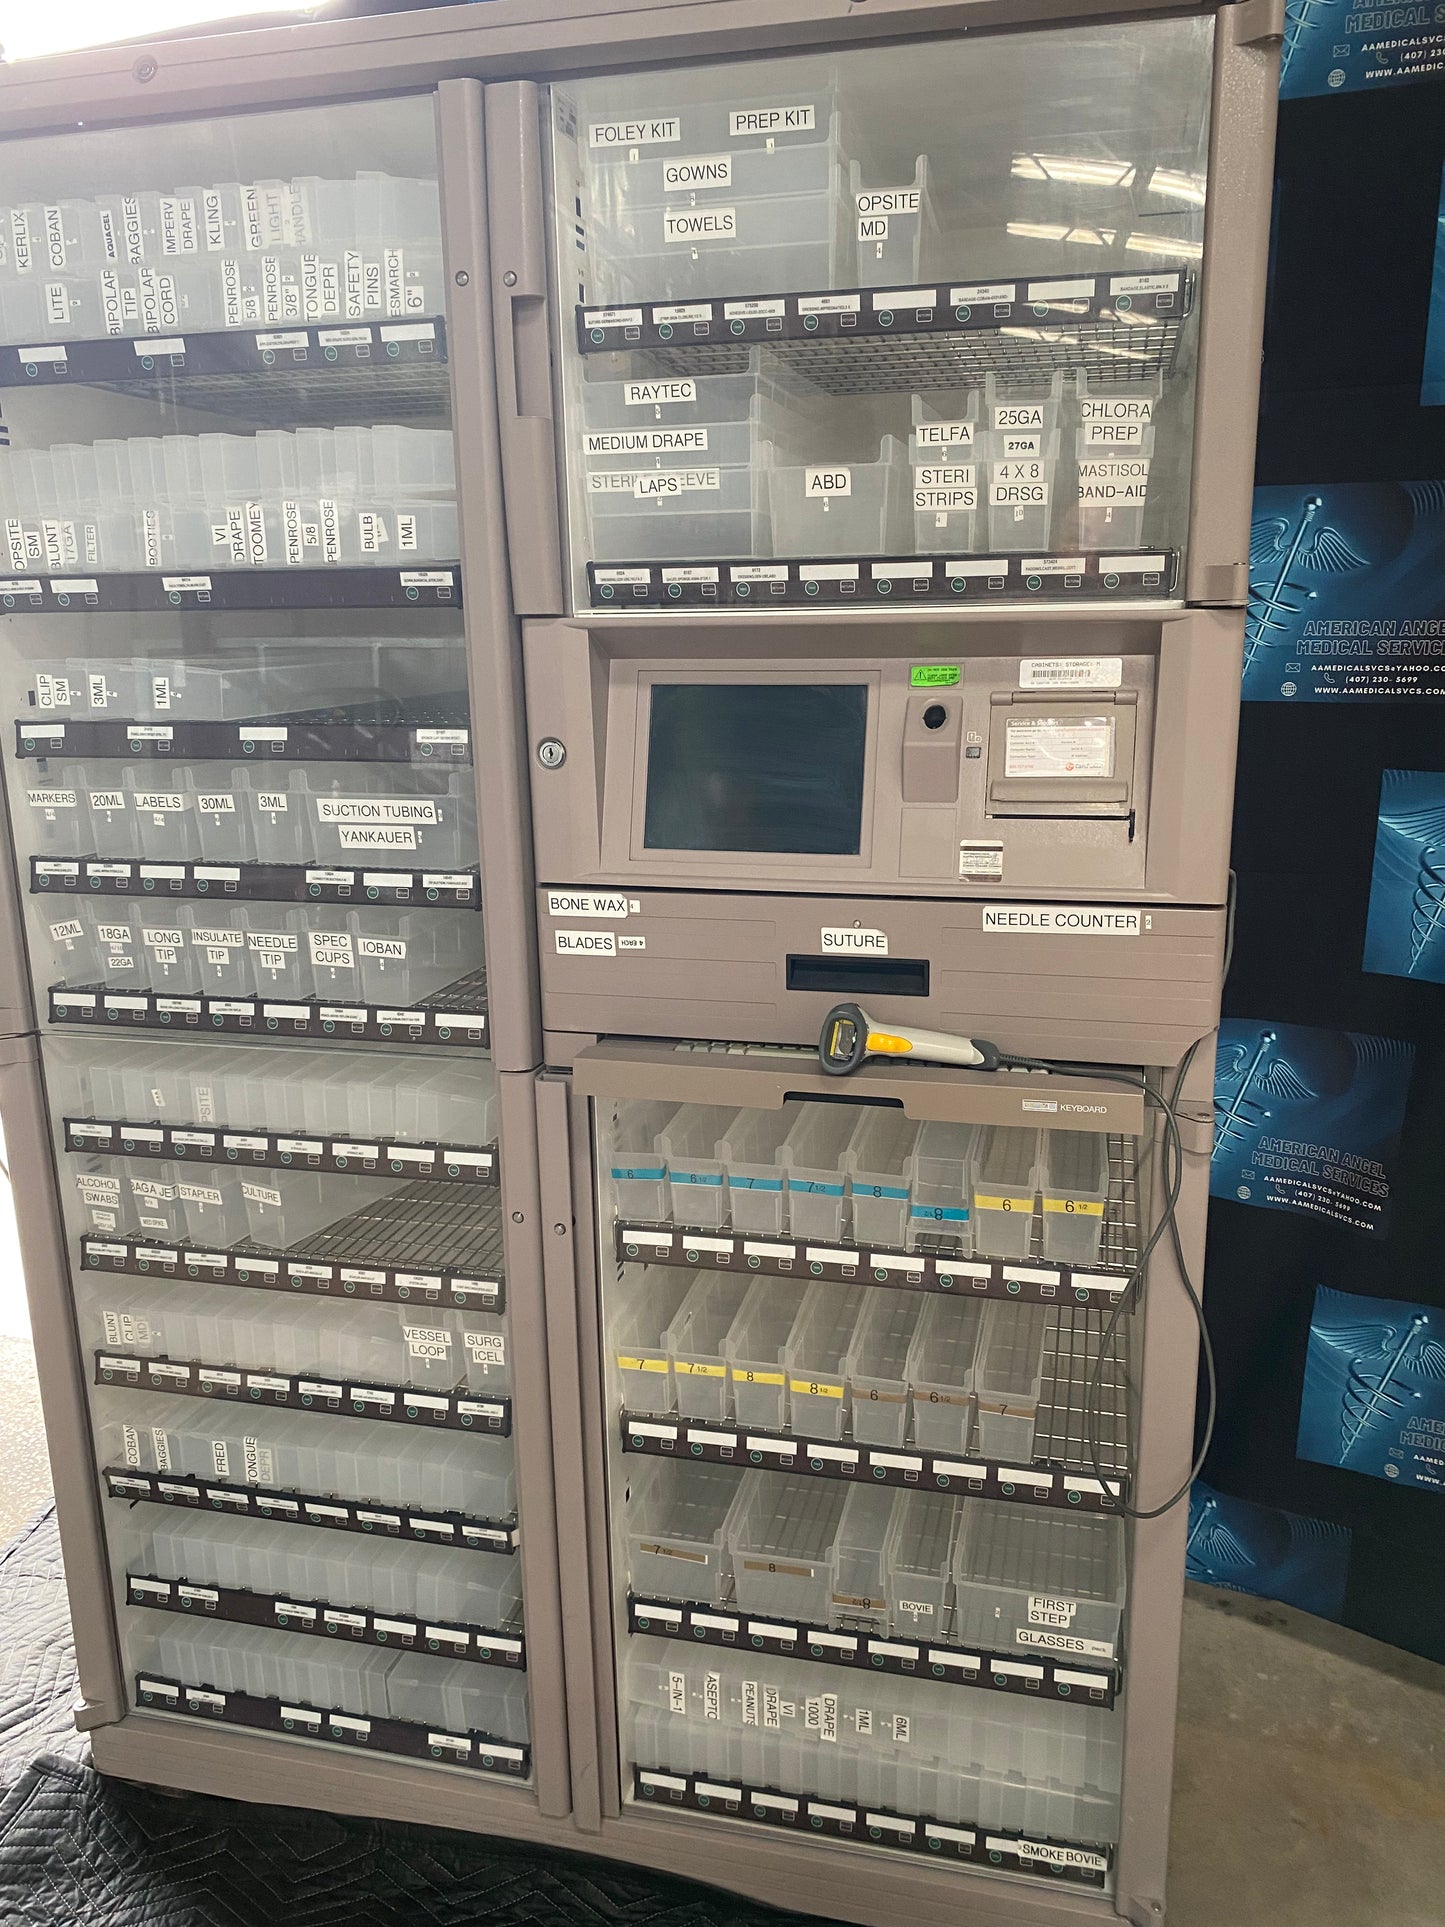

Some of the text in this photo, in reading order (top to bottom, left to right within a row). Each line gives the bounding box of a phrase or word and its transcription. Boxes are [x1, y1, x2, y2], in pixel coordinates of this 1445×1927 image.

[1345, 7, 1430, 34] MEDICAL
[736, 109, 810, 130] PREP KIT
[595, 122, 675, 142] FOLEY KIT
[666, 164, 728, 182] GOWNS
[858, 193, 919, 211] OPSITE
[206, 196, 221, 244] KLING
[266, 193, 281, 241] LIGHT
[666, 215, 733, 234] TOWELS
[126, 198, 142, 265] BAGGIES
[163, 202, 176, 252] IMPERV
[181, 202, 193, 249] DRAPE
[861, 221, 886, 236] MD
[13, 212, 28, 268] KERLIX
[48, 210, 63, 266] COBAN
[103, 214, 115, 258] AQUACEL
[265, 257, 278, 321] PENROSE
[304, 254, 318, 322] TONGUE
[323, 266, 336, 311] DEPR
[348, 252, 361, 316] SAFETY
[368, 267, 378, 305] PINS
[390, 250, 400, 317] ESMARCH
[224, 260, 238, 324] PENROSE
[408, 290, 422, 307] 6"
[51, 287, 64, 319] LITE
[104, 270, 120, 335] BIPOLAR
[125, 291, 136, 315] TIP
[142, 268, 158, 333] BIPOLAR
[160, 278, 175, 324] CORD
[286, 290, 297, 316] 3/8"
[246, 299, 257, 318] 5/8
[631, 383, 692, 400] RAYTEC
[999, 410, 1041, 425] 25GA
[1081, 403, 1151, 418] CHLORA
[919, 426, 970, 442] TELFA
[1092, 426, 1138, 440] PREP
[589, 433, 704, 450] MEDIUM DRAPE
[1008, 442, 1035, 450] 27GA
[922, 469, 969, 483] STERI
[1000, 464, 1039, 478] 4 X 8
[1078, 464, 1148, 477] MASTISOL
[639, 479, 678, 493] LAPS
[812, 474, 847, 490] ABD
[916, 492, 974, 506] STRIPS
[996, 487, 1043, 501] DRSG
[1078, 485, 1147, 498] BAND-AID
[217, 528, 226, 541] VI
[229, 511, 245, 562] DRAPE
[249, 503, 264, 564] TOOMEY
[287, 503, 300, 563] PENROSE
[306, 526, 316, 544] 5/8
[324, 501, 337, 562] PENROSE
[363, 515, 375, 549] BULB
[402, 518, 412, 546] 1ML
[8, 520, 25, 571] OPSITE
[28, 534, 40, 556] SM
[45, 525, 61, 570] BLUNT
[86, 527, 95, 562] FILTER
[1303, 620, 1396, 636] AMERICAN
[1297, 640, 1373, 655] MEDICAL
[1345, 676, 1369, 684] (407)
[40, 676, 51, 706] CLIP
[58, 681, 67, 701] SM
[94, 678, 104, 704] 3ML
[157, 680, 167, 705] 1ML
[28, 793, 76, 804] MARKERS
[92, 794, 123, 807] 20ML
[135, 796, 181, 808] LABELS
[201, 798, 232, 810] 30ML
[260, 796, 285, 808] 3ML
[322, 803, 433, 818] SUCTION TUBING
[341, 830, 413, 844] YANKAUER
[550, 898, 625, 912] BONE WAX
[985, 913, 1137, 928] NEEDLE COUNTER
[52, 924, 81, 937] 12ML
[100, 928, 130, 940] 18GA
[147, 932, 180, 944] LONG
[192, 931, 242, 943] INSULATE
[248, 936, 296, 949] NEEDLE
[314, 935, 348, 947] SPEC
[363, 941, 402, 955] IOBAN
[558, 936, 612, 950] BLADES
[824, 934, 885, 948] SUTURE
[156, 949, 175, 960] TIP
[209, 950, 224, 960] TIP
[262, 954, 282, 964] TIP
[316, 951, 350, 964] CUPS
[110, 958, 132, 967] 22GA
[1060, 1104, 1107, 1113] KEYBOARD
[1258, 1136, 1386, 1179] AMERICAN ANGEL
[627, 1170, 633, 1178] 6
[690, 1174, 696, 1183] 6
[1252, 1151, 1390, 1198] MEDICAL SERVICES
[77, 1177, 119, 1189] ALCOHOL
[747, 1178, 755, 1189] 7
[806, 1182, 815, 1192] 7
[86, 1193, 117, 1204] SWABS
[180, 1187, 220, 1201] STAPLER
[242, 1186, 278, 1202] CULTURE
[873, 1186, 881, 1198] 8
[1294, 1189, 1316, 1200] (407)
[1003, 1199, 1011, 1212] 6
[1065, 1200, 1075, 1212] 6
[934, 1208, 943, 1221] 8
[106, 1312, 117, 1343] BLUNT
[403, 1329, 450, 1343] VESSEL
[467, 1335, 501, 1347] SURG
[412, 1345, 444, 1356] LOOP
[475, 1351, 502, 1362] ICEL
[637, 1359, 645, 1370] 7
[688, 1363, 694, 1374] 7
[746, 1371, 754, 1382] 8
[810, 1382, 818, 1394] 8
[870, 1390, 878, 1401] 6
[930, 1392, 939, 1403] 6
[1000, 1404, 1008, 1415] 7
[126, 1426, 138, 1464] COBAN
[156, 1430, 168, 1470] BAGGIES
[214, 1442, 227, 1472] FRED
[246, 1436, 257, 1484] TONGUE
[260, 1451, 270, 1480] DEPR
[653, 1545, 661, 1555] 7
[768, 1563, 776, 1572] 8
[902, 1602, 931, 1613] BOVIE
[1033, 1598, 1075, 1613] FIRST
[1030, 1611, 1067, 1624] STEP
[1018, 1632, 1084, 1650] GLASSES
[672, 1676, 683, 1712] 5-IN-1
[745, 1682, 755, 1725] PEANUTS
[766, 1688, 778, 1726] DRAPE
[782, 1705, 793, 1715] VI
[808, 1701, 819, 1726] 1000
[824, 1698, 835, 1737] DRAPE
[858, 1711, 870, 1730] 1ML
[896, 1717, 907, 1739] 6ML
[1023, 1844, 1102, 1866] SMOKE BOVIE
